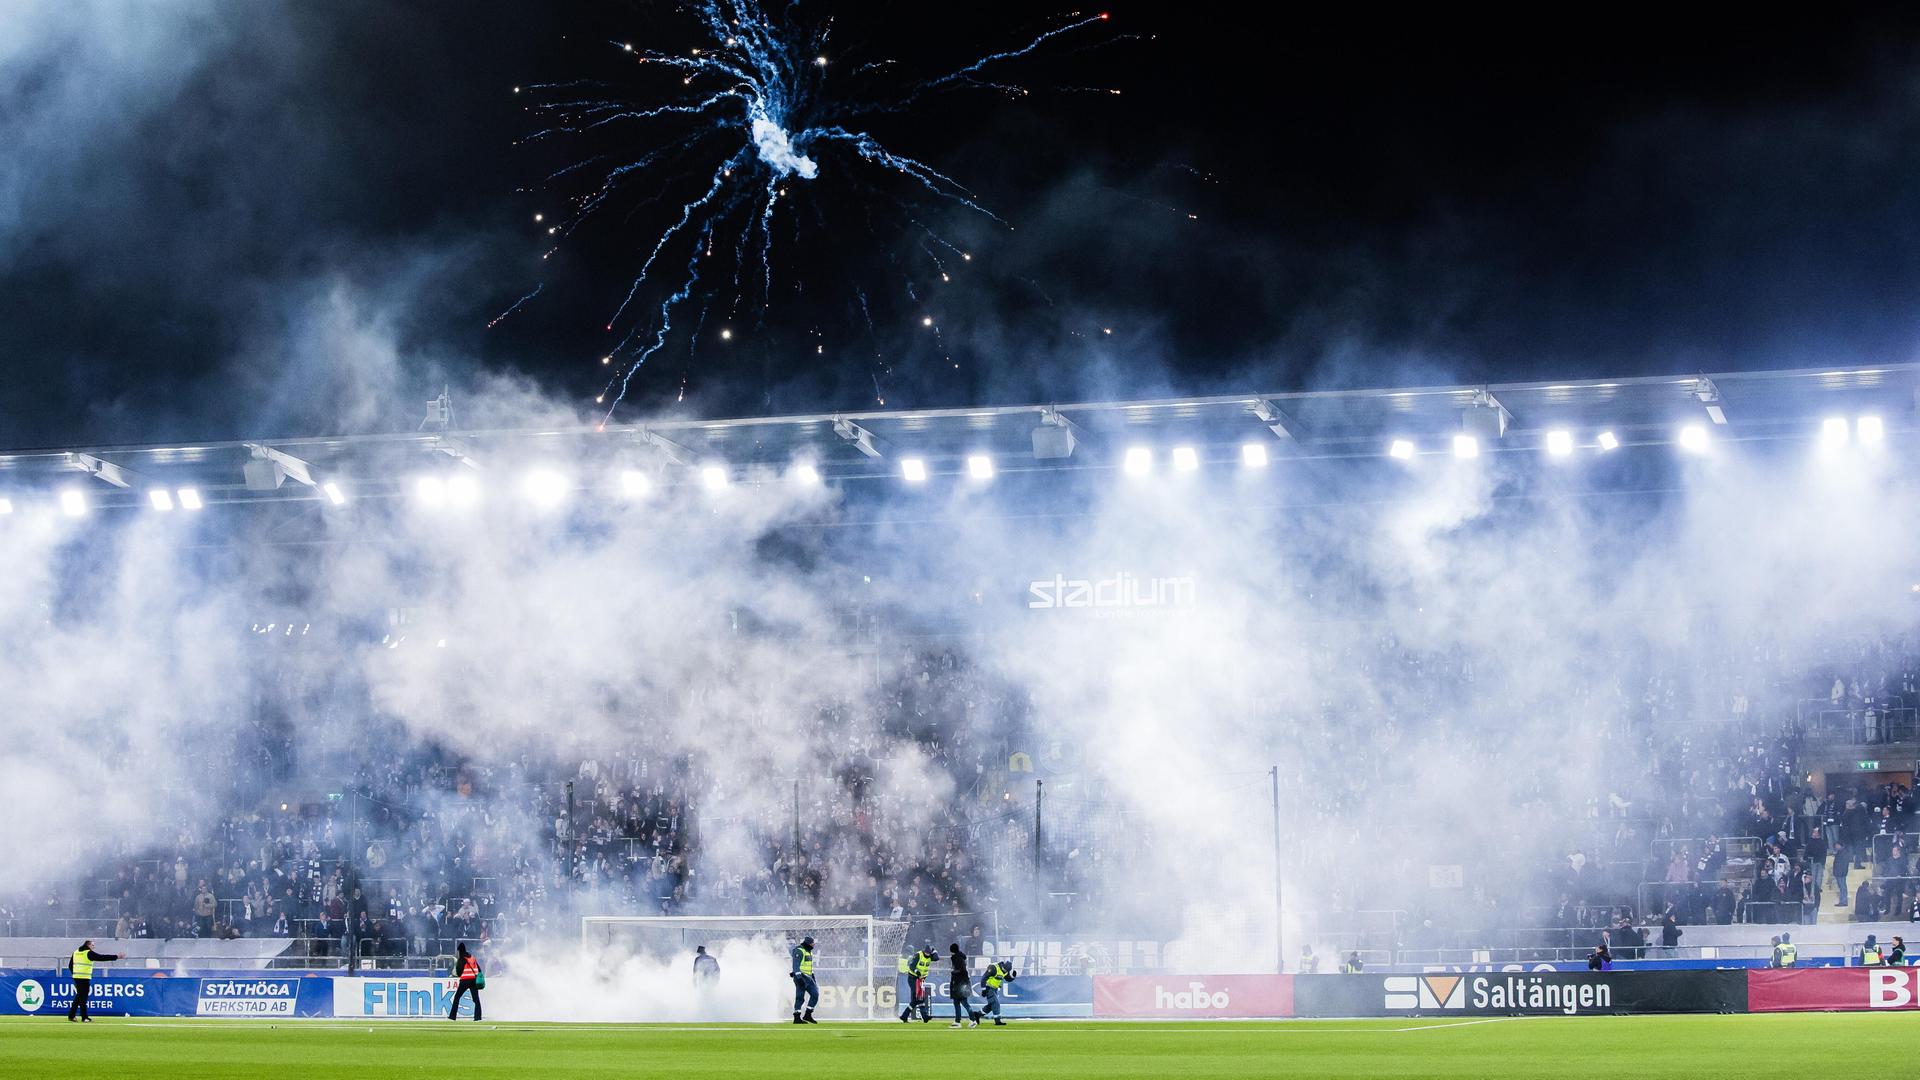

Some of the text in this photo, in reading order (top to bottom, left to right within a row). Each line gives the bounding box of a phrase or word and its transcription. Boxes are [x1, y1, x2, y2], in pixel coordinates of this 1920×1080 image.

[1029, 571, 1196, 608] stadium
[206, 981, 290, 996] STÅTHÖGA
[1155, 982, 1230, 1009] habo
[1473, 977, 1611, 1014] Saltängen
[52, 1001, 113, 1009] FASTHETER
[204, 1001, 288, 1011] VERKSTAD AB
